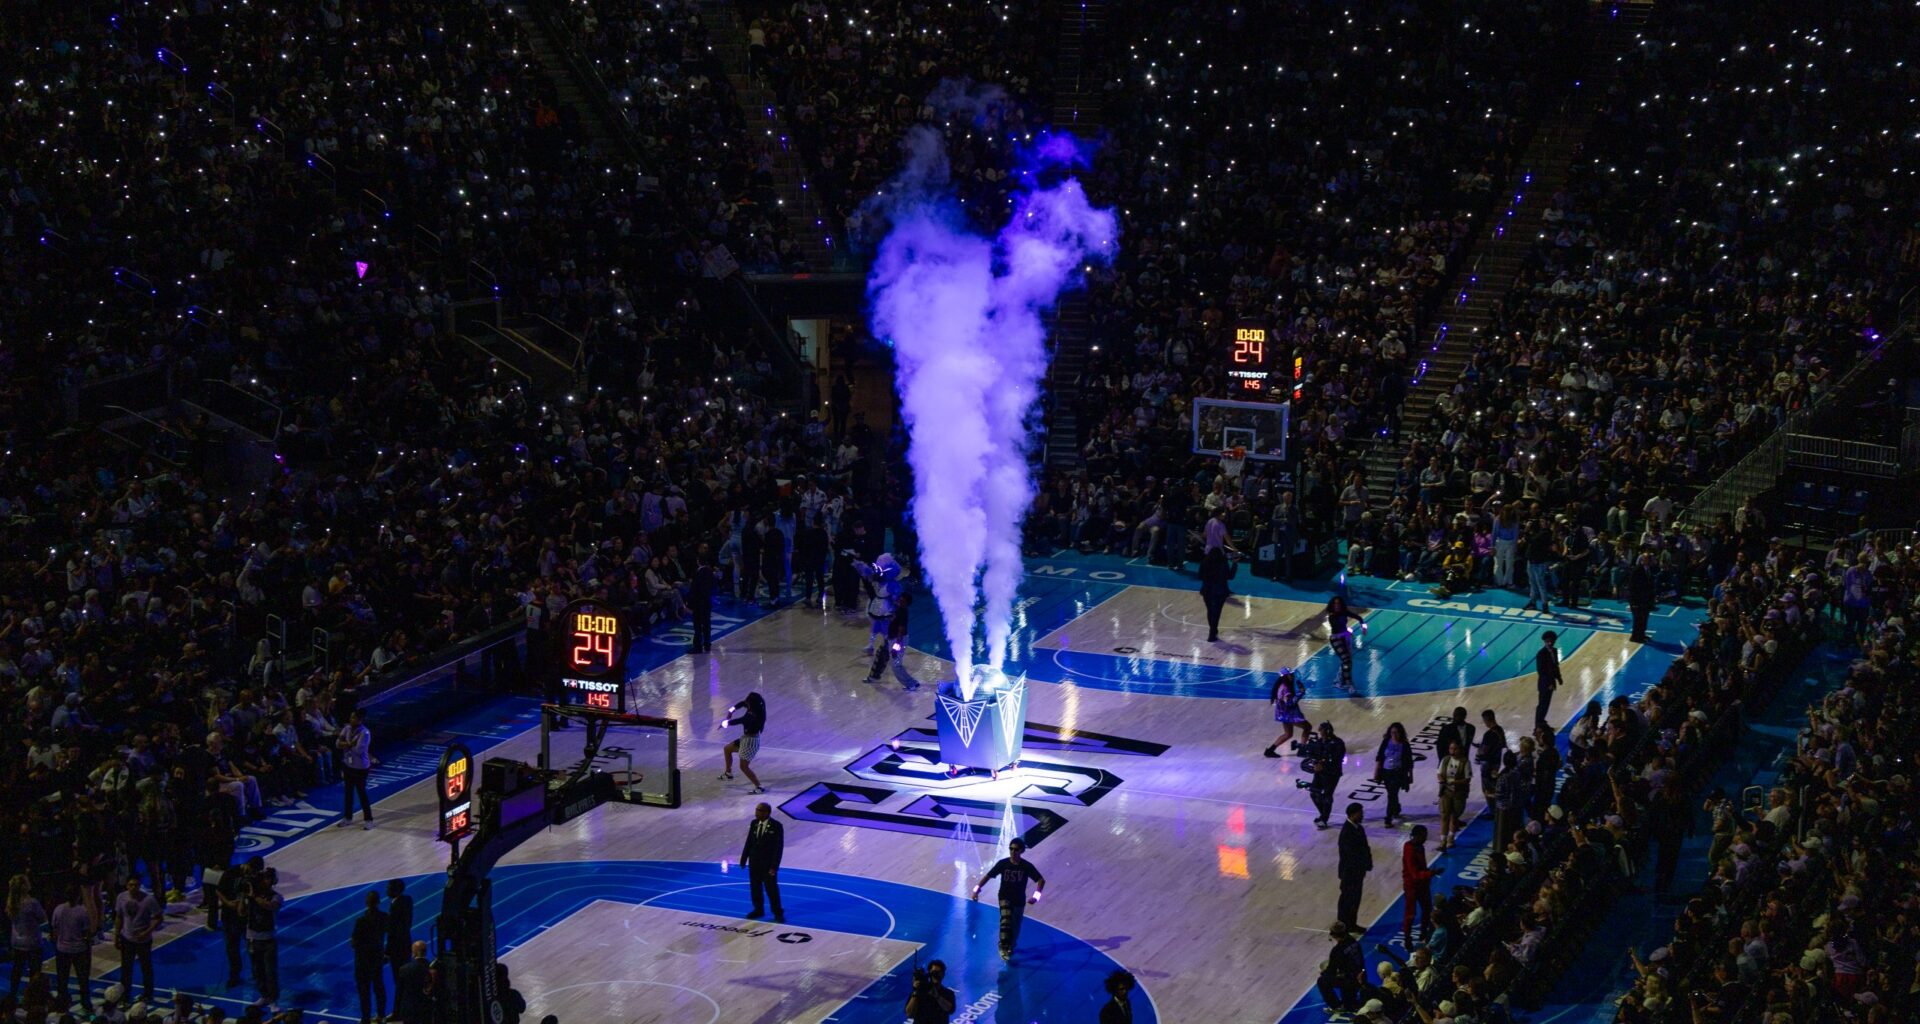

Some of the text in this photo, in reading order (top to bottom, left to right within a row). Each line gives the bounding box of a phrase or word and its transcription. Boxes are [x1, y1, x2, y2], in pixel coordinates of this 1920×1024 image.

[1237, 328, 1265, 342] 10:00
[1234, 341, 1263, 363] 24
[1244, 380, 1260, 390] 1:45
[577, 614, 616, 634] 10:00
[573, 632, 613, 667] 24
[578, 679, 619, 693] TISSOT
[587, 693, 609, 708] 1:45
[448, 774, 465, 797] 24
[233, 801, 341, 854] OLLY
